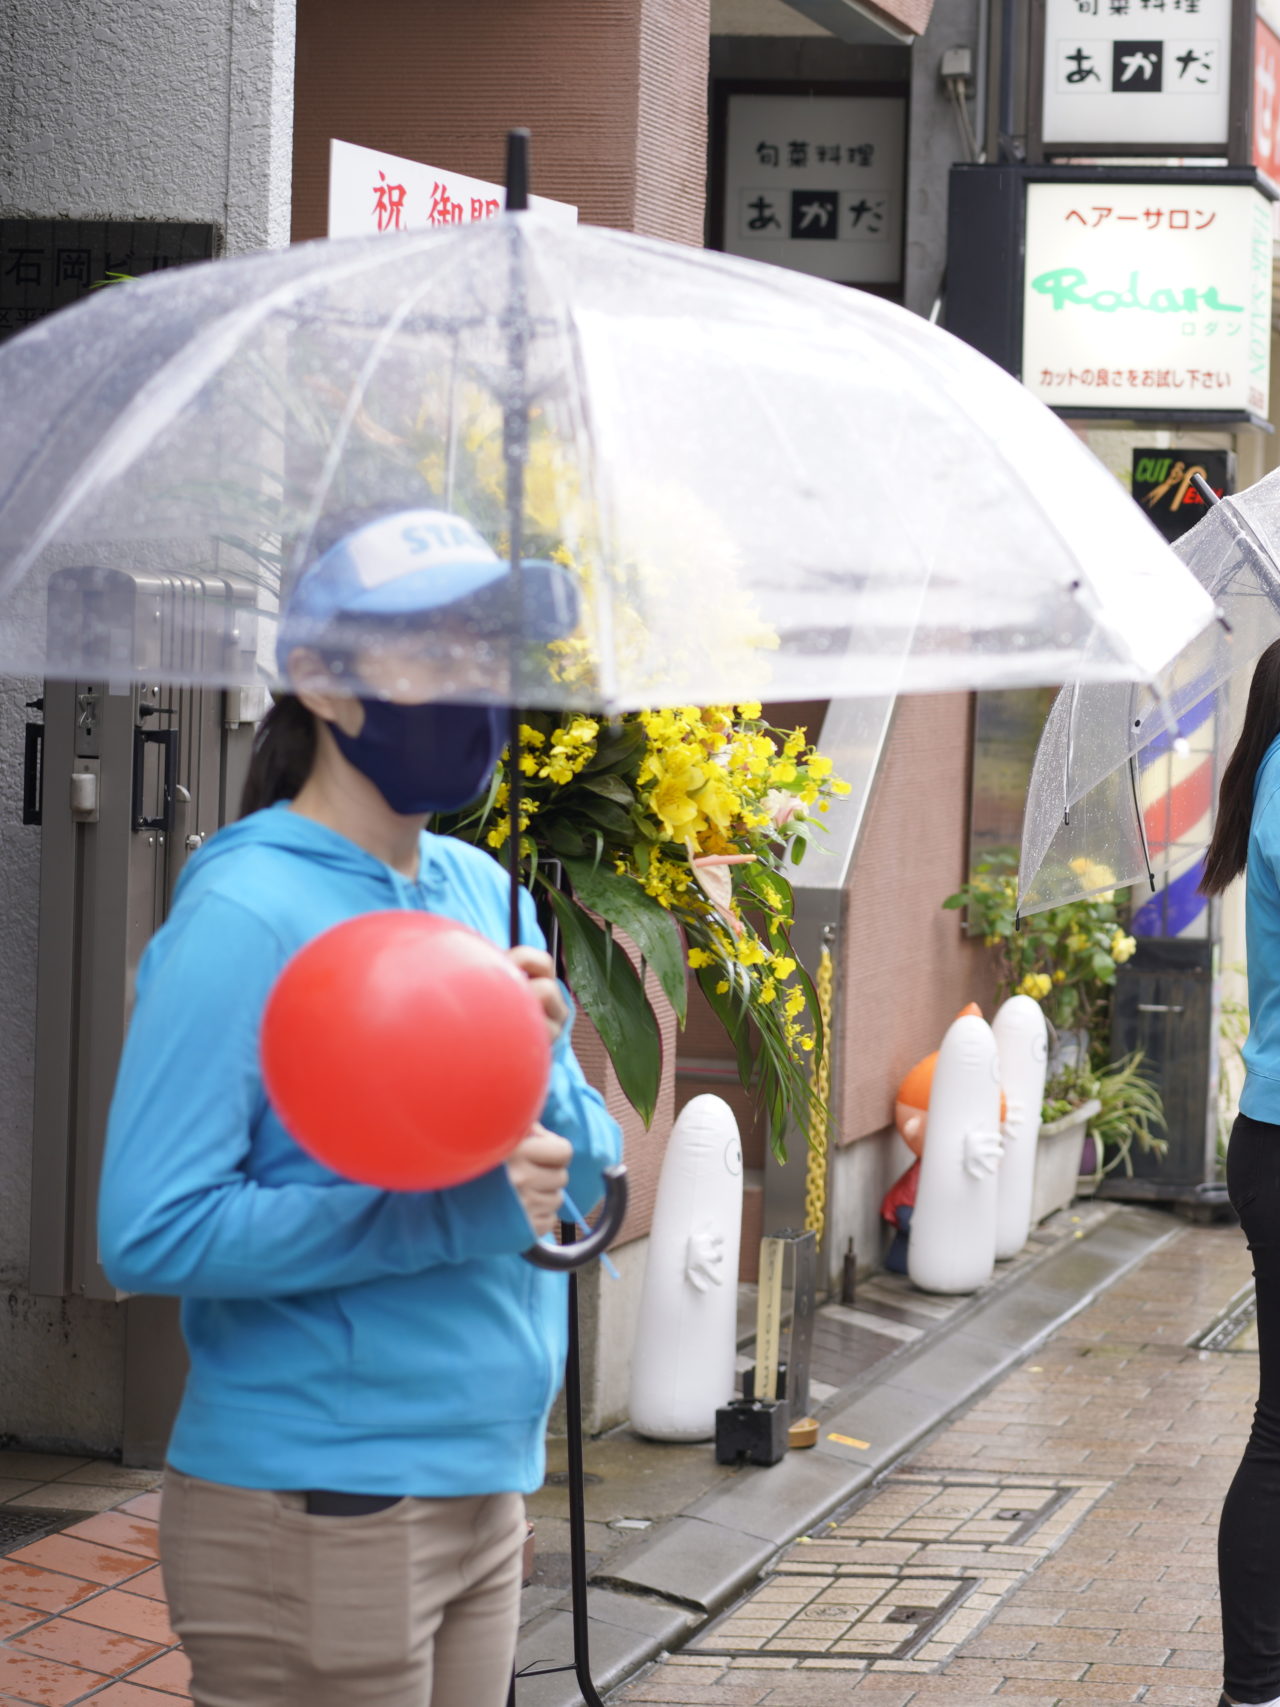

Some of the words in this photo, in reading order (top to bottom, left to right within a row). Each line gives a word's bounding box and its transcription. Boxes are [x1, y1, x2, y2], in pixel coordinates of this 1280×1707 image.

[1064, 47, 1213, 84] あかだ
[756, 140, 876, 168] 旬菜料理
[747, 194, 885, 233] あかだ
[1065, 206, 1217, 230] ヘアーサロン
[1181, 321, 1242, 337] ロダン
[1040, 368, 1232, 389] カットの良さをお試し下さい
[1135, 457, 1173, 483] CUT
